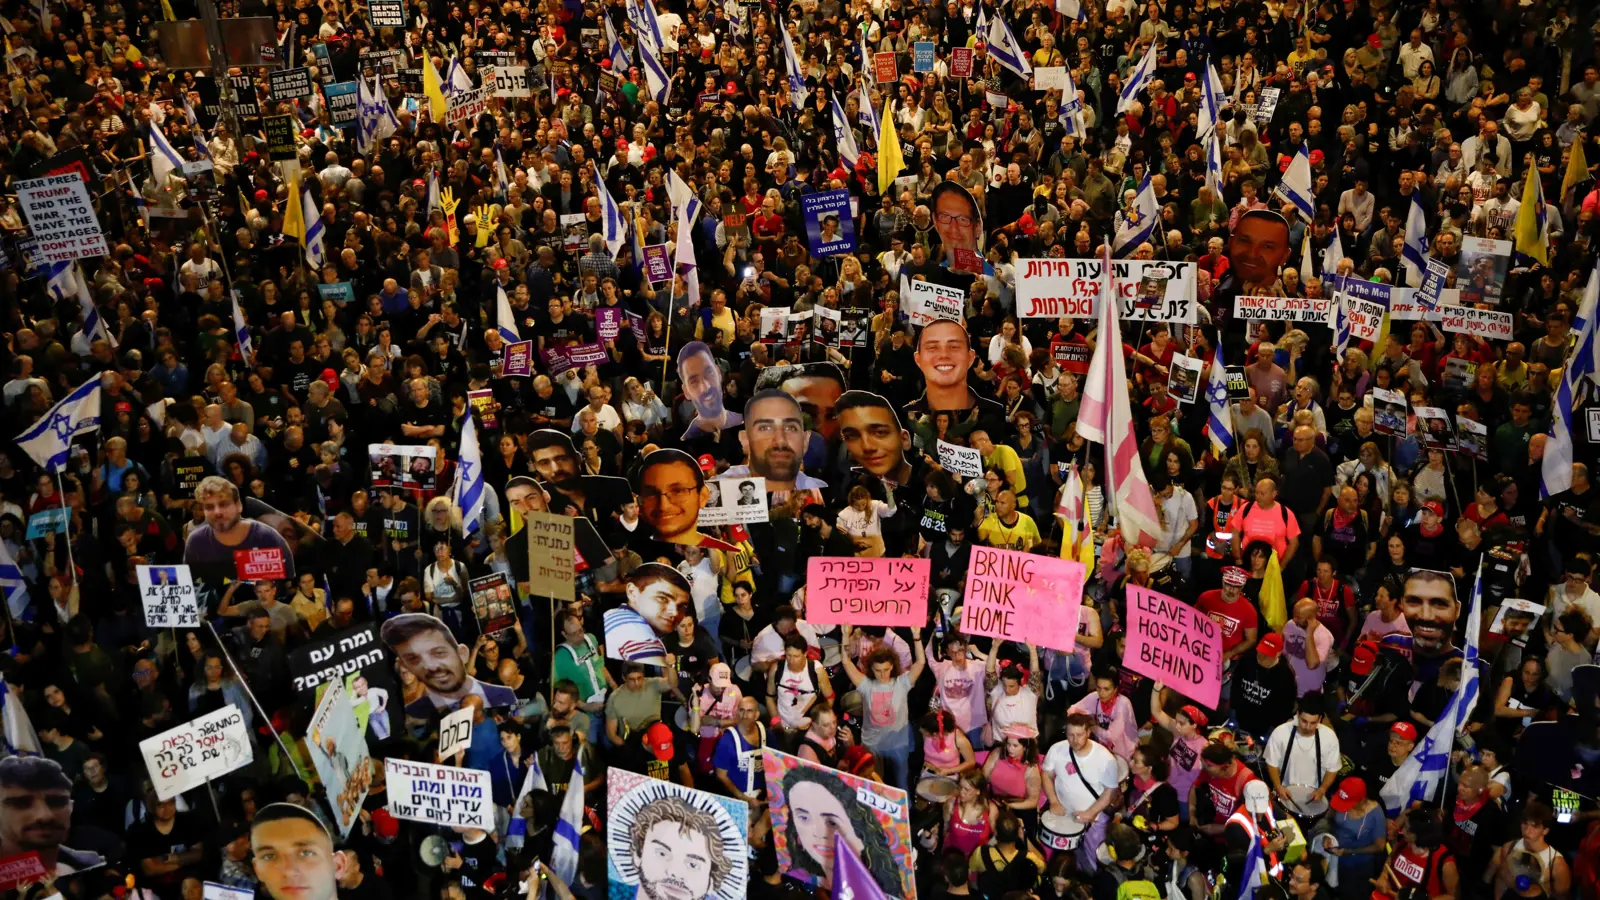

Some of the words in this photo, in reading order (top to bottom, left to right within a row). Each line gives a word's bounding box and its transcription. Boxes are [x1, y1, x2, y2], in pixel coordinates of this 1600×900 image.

[274, 80, 308, 91] המלחמה
[267, 118, 288, 127] WAR
[14, 179, 46, 191] DEAR
[48, 174, 83, 187] PRES.
[29, 187, 76, 200] TRUMP,
[817, 195, 833, 203] ניצחון
[30, 200, 55, 211] END
[57, 196, 82, 206] THE
[68, 206, 88, 217] TO
[806, 205, 821, 213] גולדין
[35, 221, 66, 232] SAVE
[69, 215, 93, 227] THE
[724, 214, 745, 227] HELP
[36, 226, 100, 242] HOSTAGES
[42, 239, 76, 252] DON'T
[80, 235, 102, 247] LET
[839, 242, 851, 250] עוז
[46, 249, 75, 262] THEM
[83, 245, 106, 257] DIE!
[1023, 260, 1070, 279] חירות
[914, 283, 934, 294] רעים
[936, 286, 963, 300] דברים
[1356, 283, 1370, 295] The
[1371, 286, 1390, 299] Men
[936, 295, 960, 310] קורים
[1025, 297, 1093, 317] ואזרחות
[1239, 297, 1265, 309] שמחה
[1266, 298, 1282, 309] לא
[1314, 300, 1330, 311] לא
[1239, 307, 1267, 319] חטופה
[1271, 309, 1297, 320] מדינה
[1302, 310, 1329, 322] אנחנו
[1478, 311, 1498, 321] פורים
[534, 520, 573, 536] מורשת
[250, 550, 280, 562] עדיין
[552, 555, 573, 569] בתי
[538, 566, 573, 583] קברות
[820, 561, 875, 574] כפרה
[888, 561, 914, 576] אין
[974, 550, 1036, 585] BRING
[818, 577, 881, 594] הפקרת
[892, 578, 916, 594] על
[970, 578, 1016, 610] PINK
[829, 598, 911, 615] החטופים
[966, 605, 1016, 637] HOME
[1136, 591, 1189, 628] LEAVE
[1193, 613, 1215, 639] NO
[339, 629, 374, 653] ומה
[1139, 615, 1212, 663] HOSTAGE
[309, 644, 335, 665] עם
[294, 649, 385, 692] החטופים?
[1140, 642, 1204, 685] BEHIND
[440, 719, 471, 754] כולם
[412, 779, 446, 795] ומתן
[451, 783, 483, 799] מתן
[411, 793, 442, 809] חיים
[446, 798, 482, 812] עדיין
[858, 790, 900, 815] ענבר
[425, 808, 452, 823] להם
[457, 812, 482, 825] ואין
